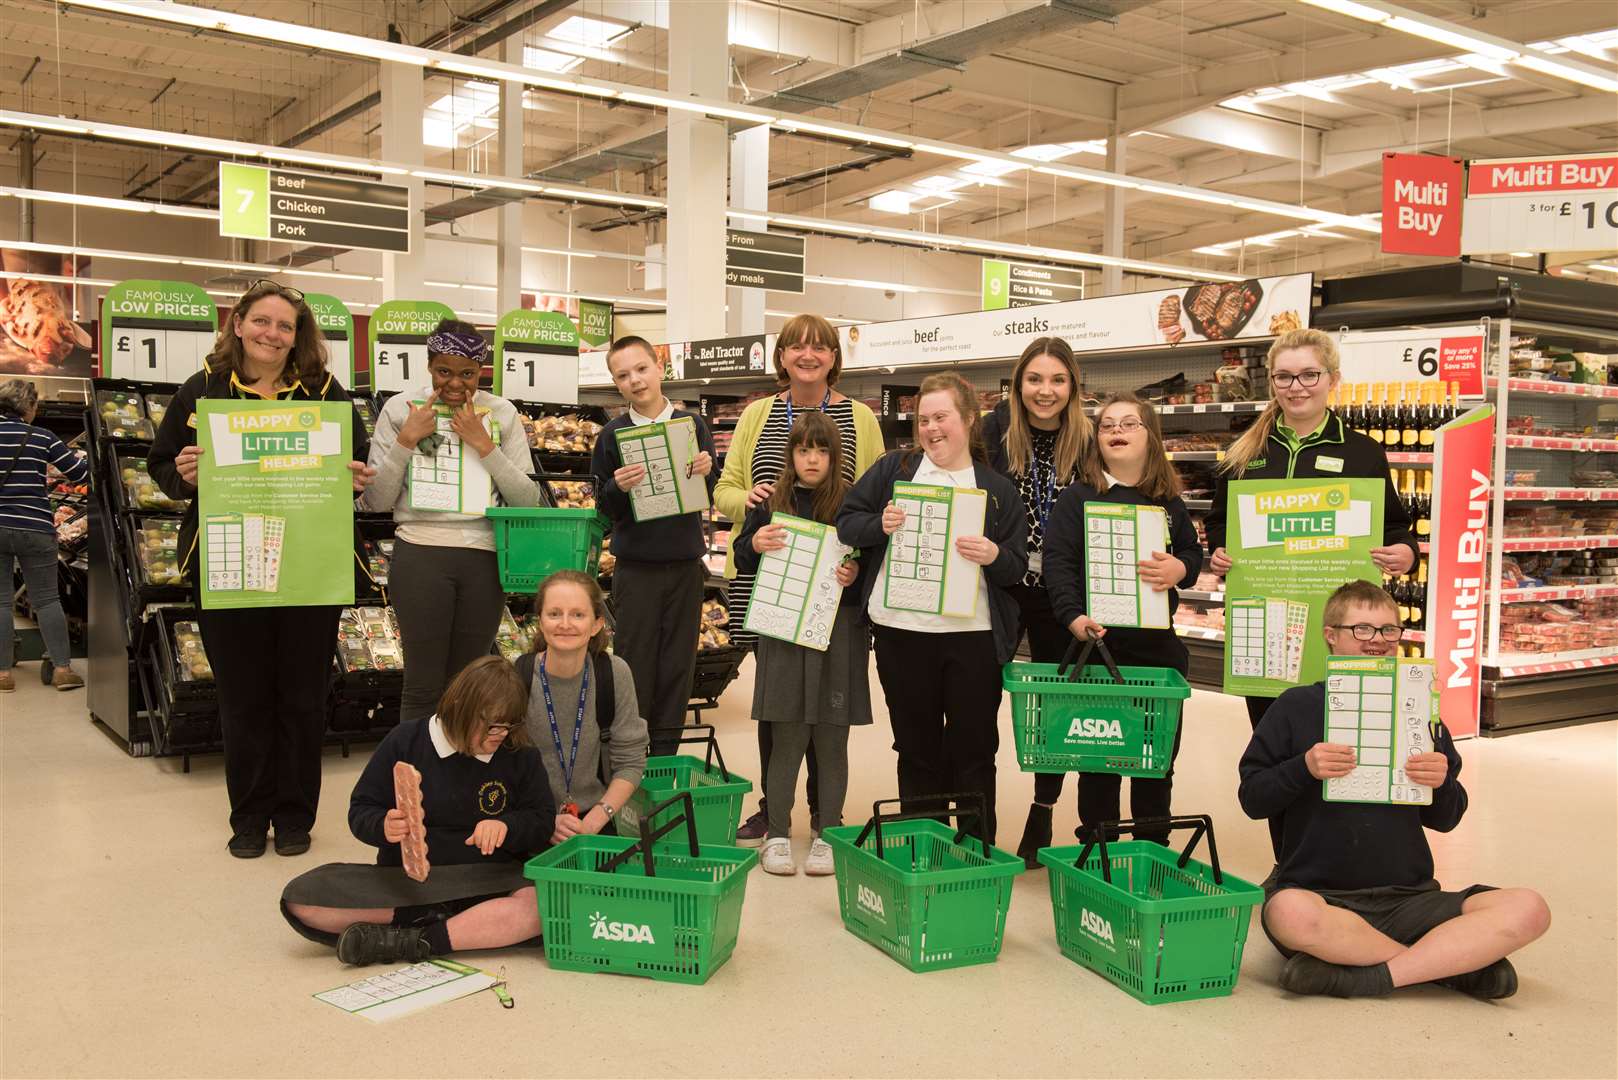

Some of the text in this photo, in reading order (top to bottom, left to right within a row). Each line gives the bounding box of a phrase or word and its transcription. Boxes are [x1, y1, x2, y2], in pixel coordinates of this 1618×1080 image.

[277, 176, 306, 190] Beef
[1492, 163, 1614, 188] Multi Buy
[235, 188, 255, 214] 7
[1394, 179, 1448, 207] Multi
[277, 199, 326, 215] Chicken
[1529, 204, 1536, 213] 3
[1540, 204, 1555, 212] for
[1559, 201, 1572, 216] £
[1398, 206, 1443, 236] Buy
[277, 223, 306, 236] Pork
[731, 234, 755, 246] From
[739, 273, 765, 285] meals
[1012, 267, 1052, 280] Condiments
[989, 278, 1002, 296] 9
[1013, 284, 1053, 297] Rice & Pasta
[125, 289, 194, 304] FAMOUSLY
[111, 300, 211, 317] LOW PRICES
[387, 310, 443, 322] FAMOUSLY
[314, 314, 348, 327] ICES
[376, 321, 440, 334] LOW PRIC
[512, 317, 564, 331] FAMOUSLY
[583, 313, 606, 327] LOW
[1004, 316, 1049, 336] steaks
[502, 326, 575, 343] LOW PRICES
[583, 325, 607, 337] PRICES
[914, 327, 940, 344] beef
[117, 336, 157, 369] £ 1
[700, 346, 715, 360] Red
[715, 345, 745, 359] Tractor
[378, 350, 410, 380] £ 1
[1402, 347, 1438, 377] £ 6
[506, 358, 536, 387] £ 1
[232, 414, 293, 430] HAPPY
[245, 436, 307, 451] LITTLE
[263, 456, 319, 469] HELPER
[1259, 492, 1322, 511] HAPPY
[1270, 517, 1333, 533] LITTLE
[1288, 536, 1345, 552] HELPER
[1447, 469, 1490, 689] Multi Buy
[1067, 717, 1124, 739] ASDA
[858, 883, 885, 917] ASDA
[592, 919, 656, 945] ASDA
[1080, 907, 1115, 945] ASDA
